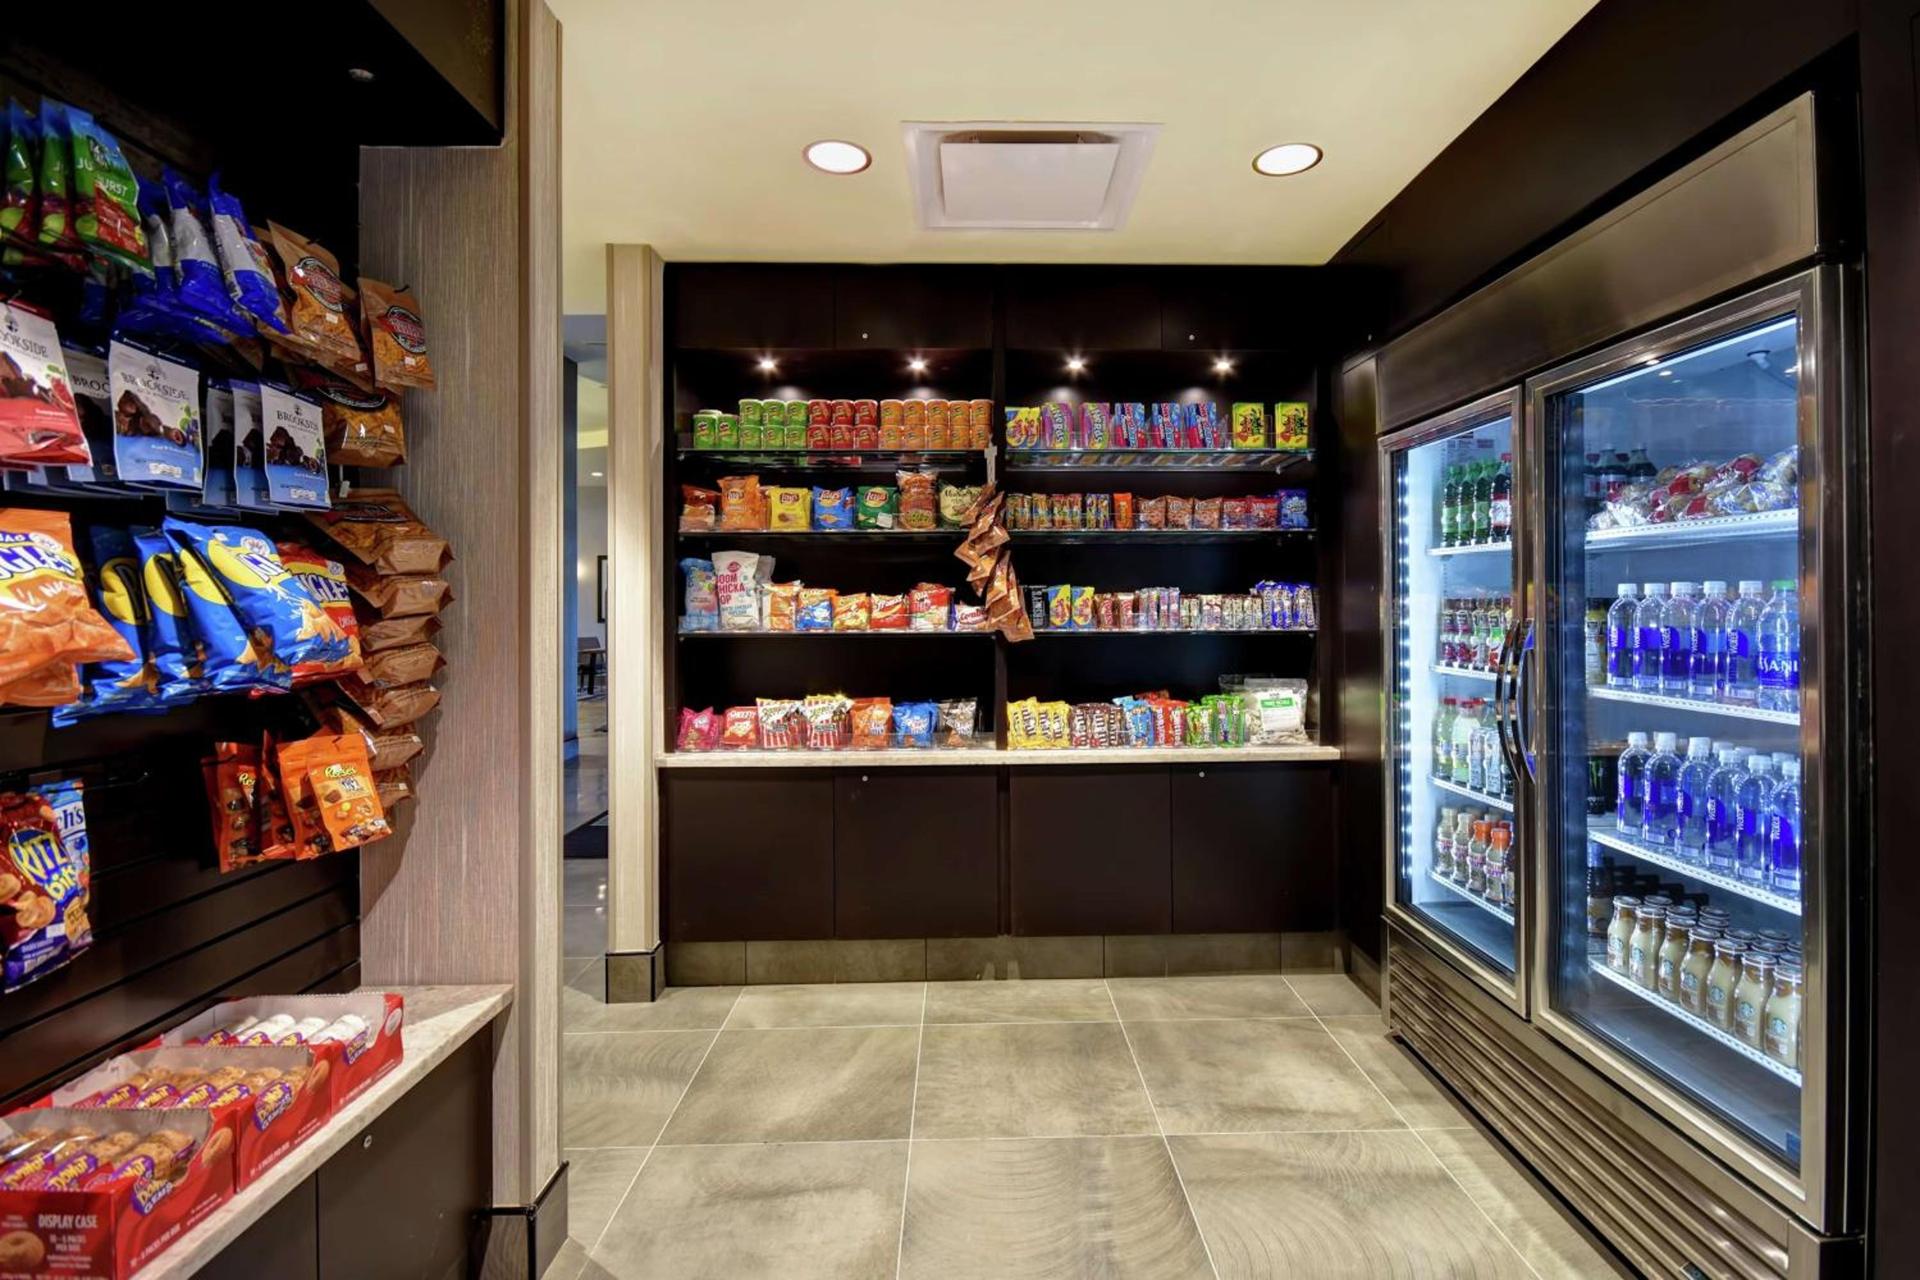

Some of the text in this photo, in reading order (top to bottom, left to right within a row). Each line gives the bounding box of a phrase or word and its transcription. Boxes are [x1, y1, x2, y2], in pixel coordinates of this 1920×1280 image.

[0, 331, 48, 358] OKSIDE
[9, 831, 69, 886] RITZ
[38, 1213, 74, 1230] DISPLAY
[75, 1214, 98, 1230] CASE
